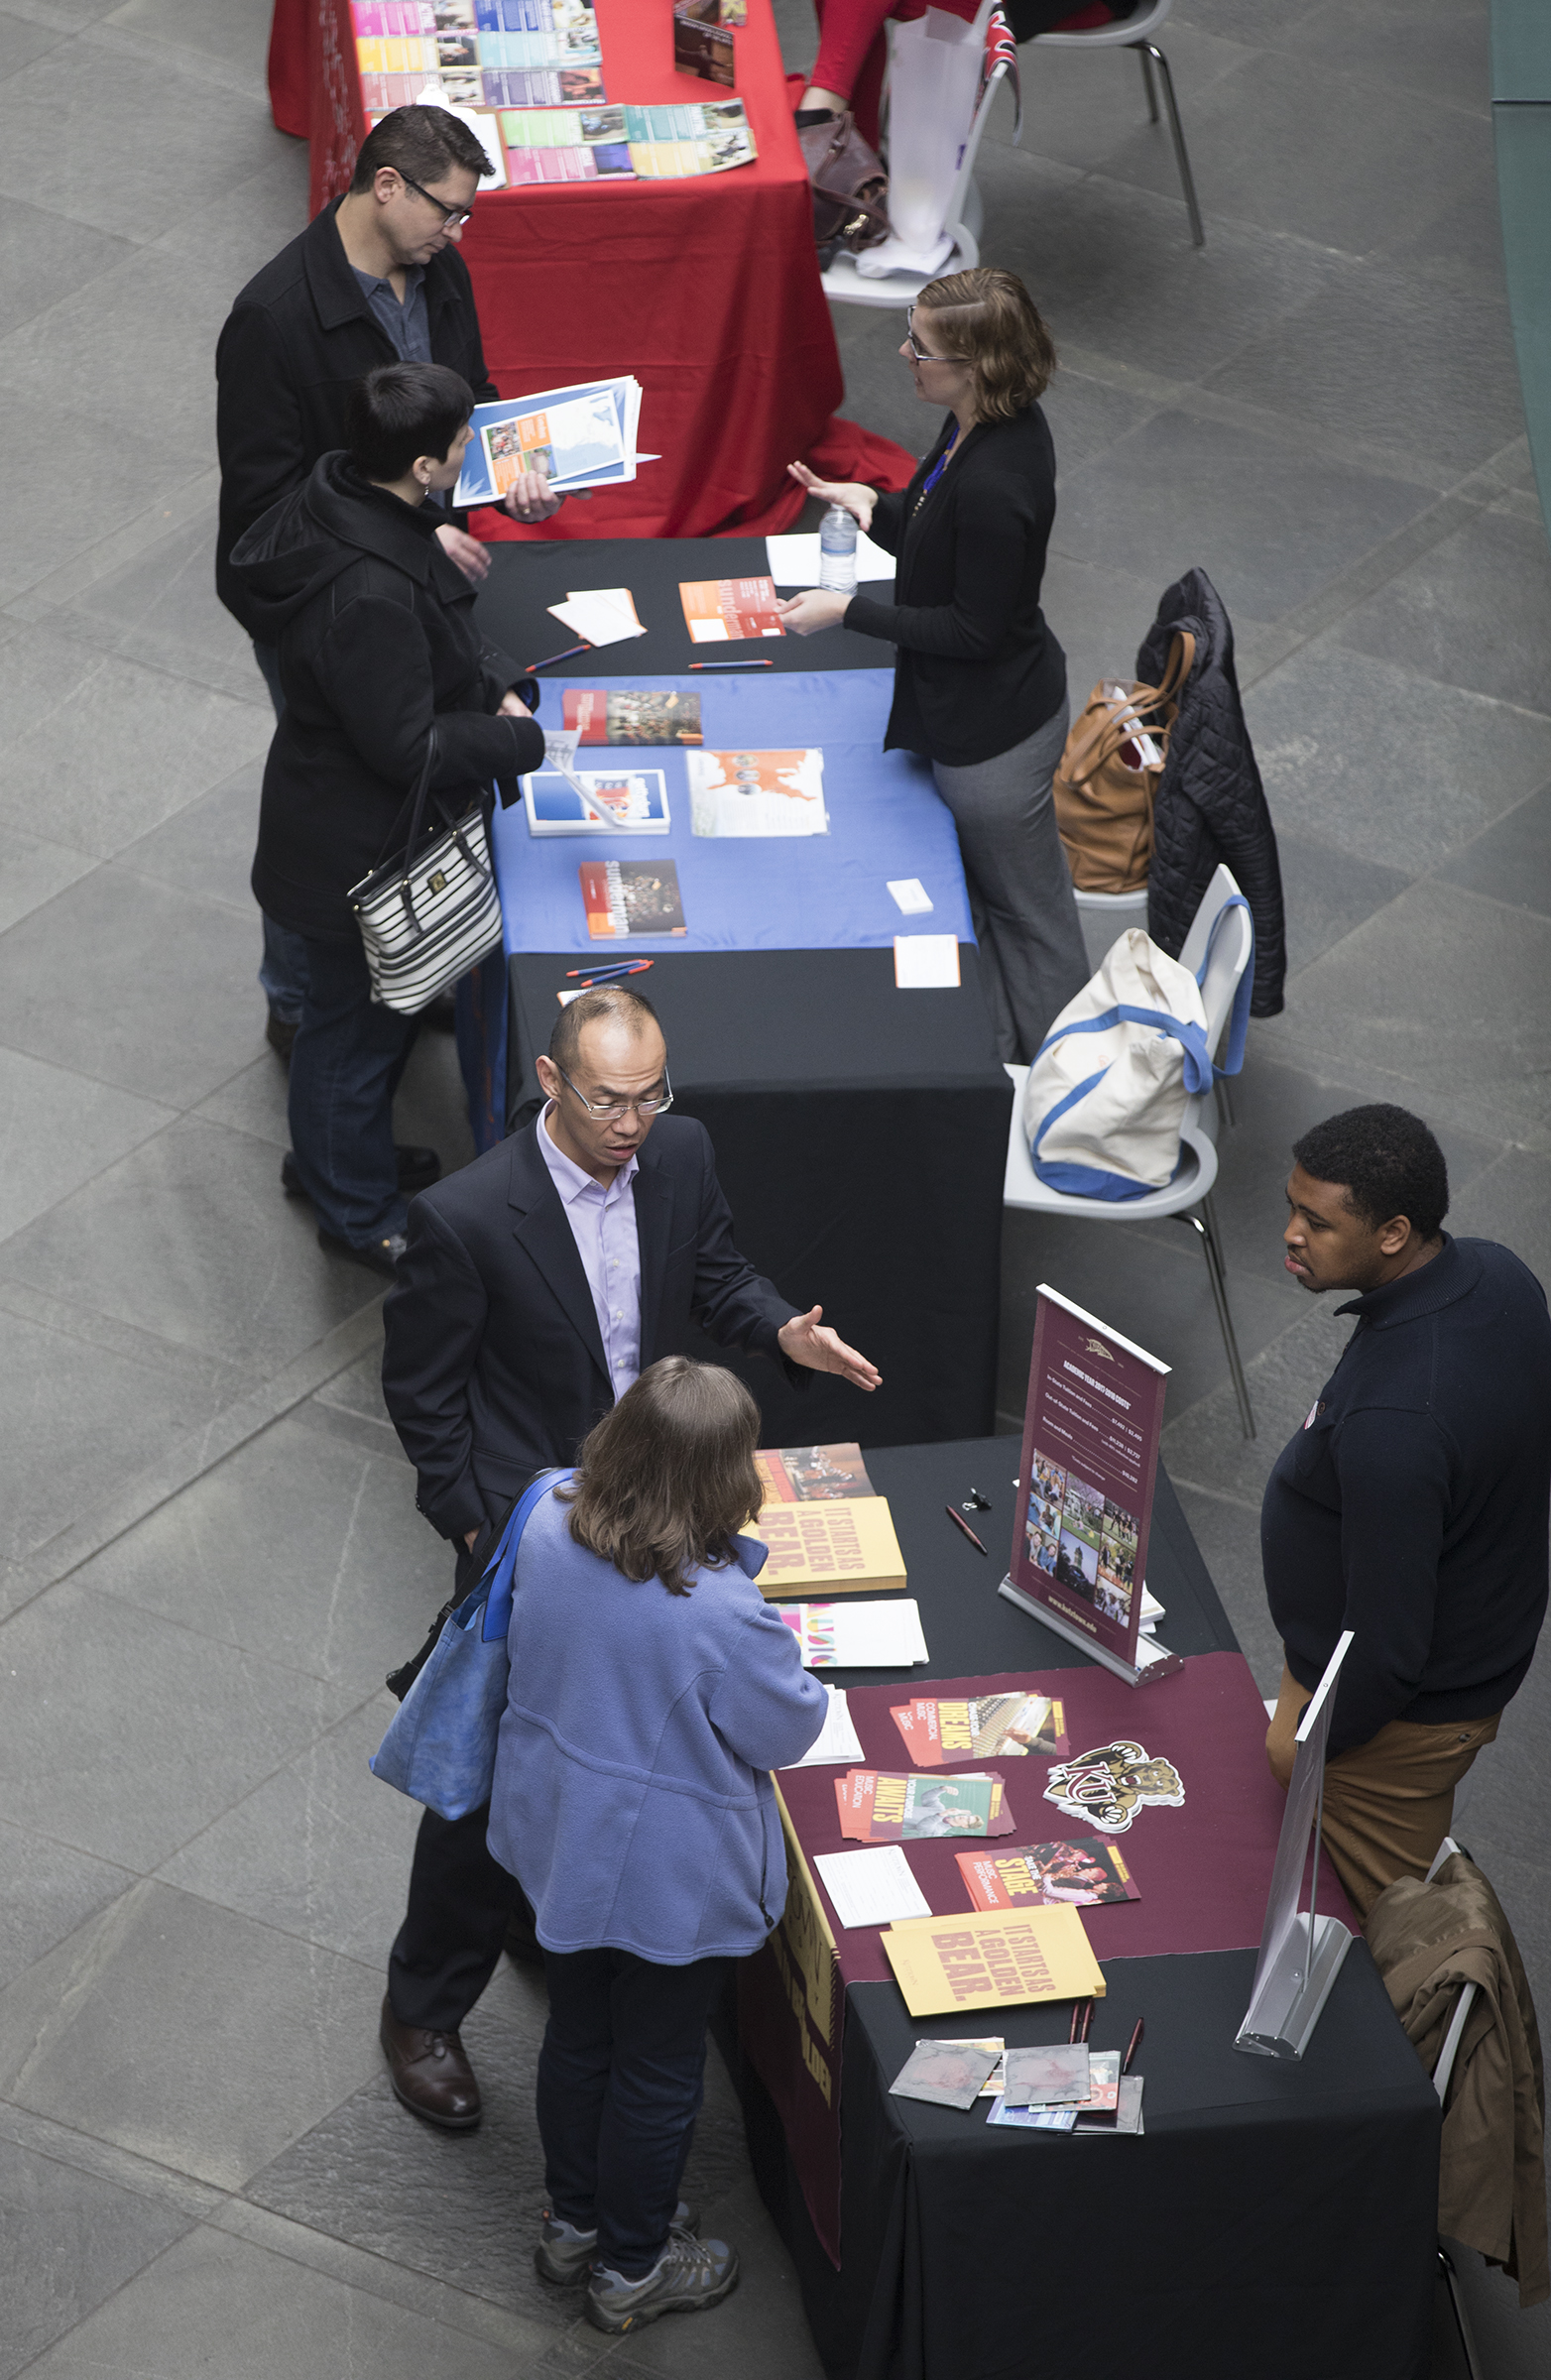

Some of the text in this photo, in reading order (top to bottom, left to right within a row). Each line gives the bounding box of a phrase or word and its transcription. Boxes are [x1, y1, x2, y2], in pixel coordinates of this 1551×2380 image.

[718, 580, 745, 640] sunderman
[605, 861, 630, 933] sunderman
[1063, 1360, 1084, 1380] ACADEMIC
[1084, 1373, 1096, 1387] YEAR
[758, 1510, 806, 1577] BEAR.
[799, 1518, 836, 1573] GOLDEN
[824, 1507, 866, 1571] IT STARTS AS
[806, 1603, 838, 1666] MUSIC
[897, 1712, 913, 1730] MUSIC
[916, 1702, 926, 1721] MUSIC
[925, 1702, 938, 1740] COMMERCIAL
[938, 1702, 973, 1749] DREAMS
[970, 1721, 980, 1736] YOUR
[852, 1775, 865, 1808] EDUCATION
[864, 1776, 875, 1795] MUSIC
[873, 1776, 907, 1823] AWAITS
[903, 1779, 917, 1820] YOUR PURPOSE
[1062, 1761, 1117, 1804] KU
[973, 1861, 1000, 1904] PERFORMANCE
[983, 1860, 998, 1879] MUSIC
[995, 1857, 1039, 1896] STAGE
[1029, 1868, 1041, 1880] THE
[930, 1931, 994, 2002] BEAR.
[974, 1929, 1025, 1997] A GOLDEN
[1003, 1924, 1056, 1993] IT STARTS AS
